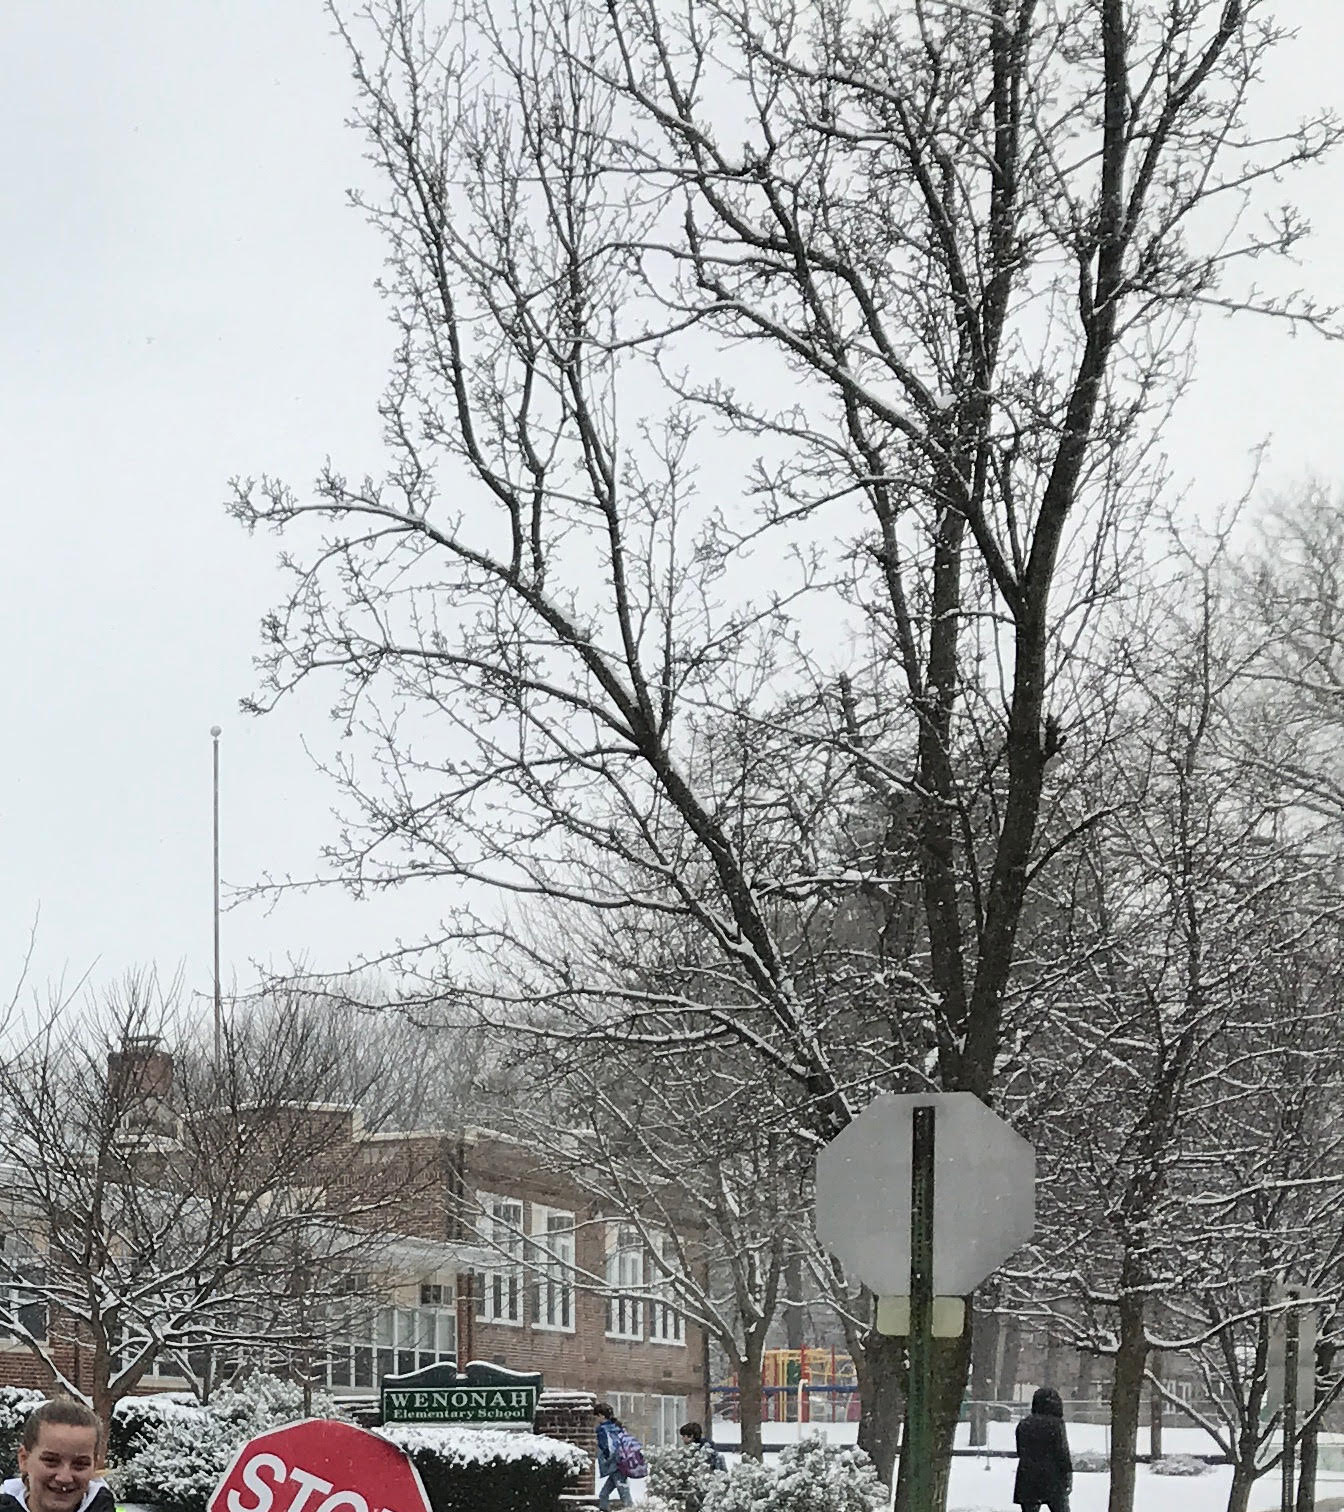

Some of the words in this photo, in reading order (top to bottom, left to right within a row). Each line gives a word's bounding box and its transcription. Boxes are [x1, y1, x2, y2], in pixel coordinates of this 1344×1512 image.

[390, 1391, 528, 1408] WENONAH
[393, 1408, 475, 1420] Elementary
[477, 1408, 525, 1419] School
